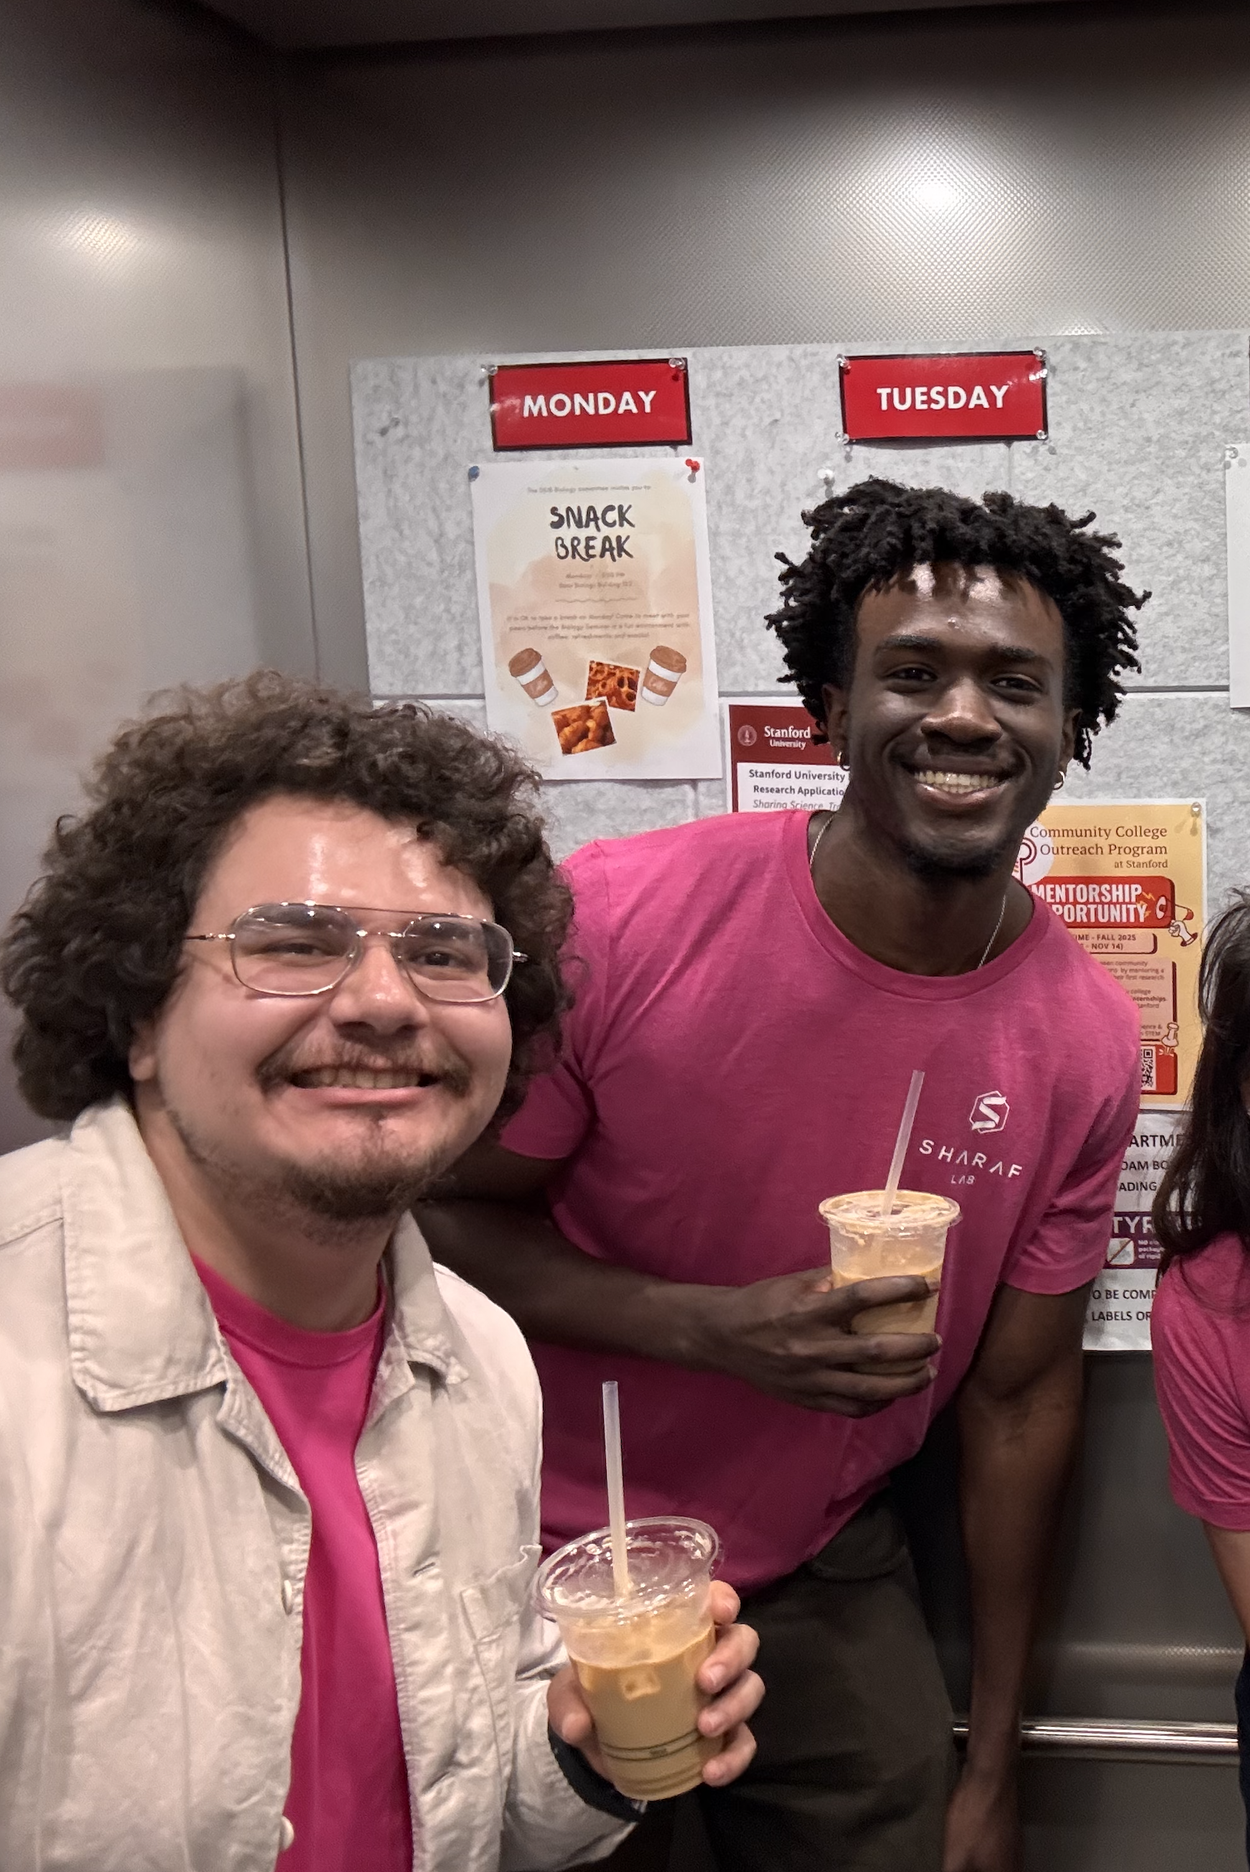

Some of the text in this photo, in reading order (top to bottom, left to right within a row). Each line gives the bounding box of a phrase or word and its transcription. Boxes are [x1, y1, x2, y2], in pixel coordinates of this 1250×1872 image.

[523, 390, 657, 418] MONDAY
[877, 385, 1010, 411] TUESDAY
[550, 504, 635, 532] SNACK
[555, 535, 633, 561] BREAK
[764, 726, 811, 751] Stanford University
[749, 769, 846, 783] Stanford University
[753, 785, 844, 797] Research Applicatio
[1030, 825, 1168, 840] Community College
[1040, 843, 1168, 858] Outreach Program
[1114, 859, 1168, 869] at Stanford
[1032, 884, 1142, 903] MENTORSHIP
[1052, 904, 1148, 923] PORTUNITY
[1075, 933, 1137, 942] IME FALL 2025
[919, 1139, 1023, 1178] SHARAF
[1121, 1160, 1168, 1171] OAM BO
[950, 1175, 975, 1185] LAB
[1119, 1182, 1157, 1192] ADING
[1113, 1215, 1153, 1234] TYR
[1105, 1289, 1120, 1300] BE
[1122, 1289, 1156, 1300] COMP
[1092, 1310, 1133, 1321] LABELS
